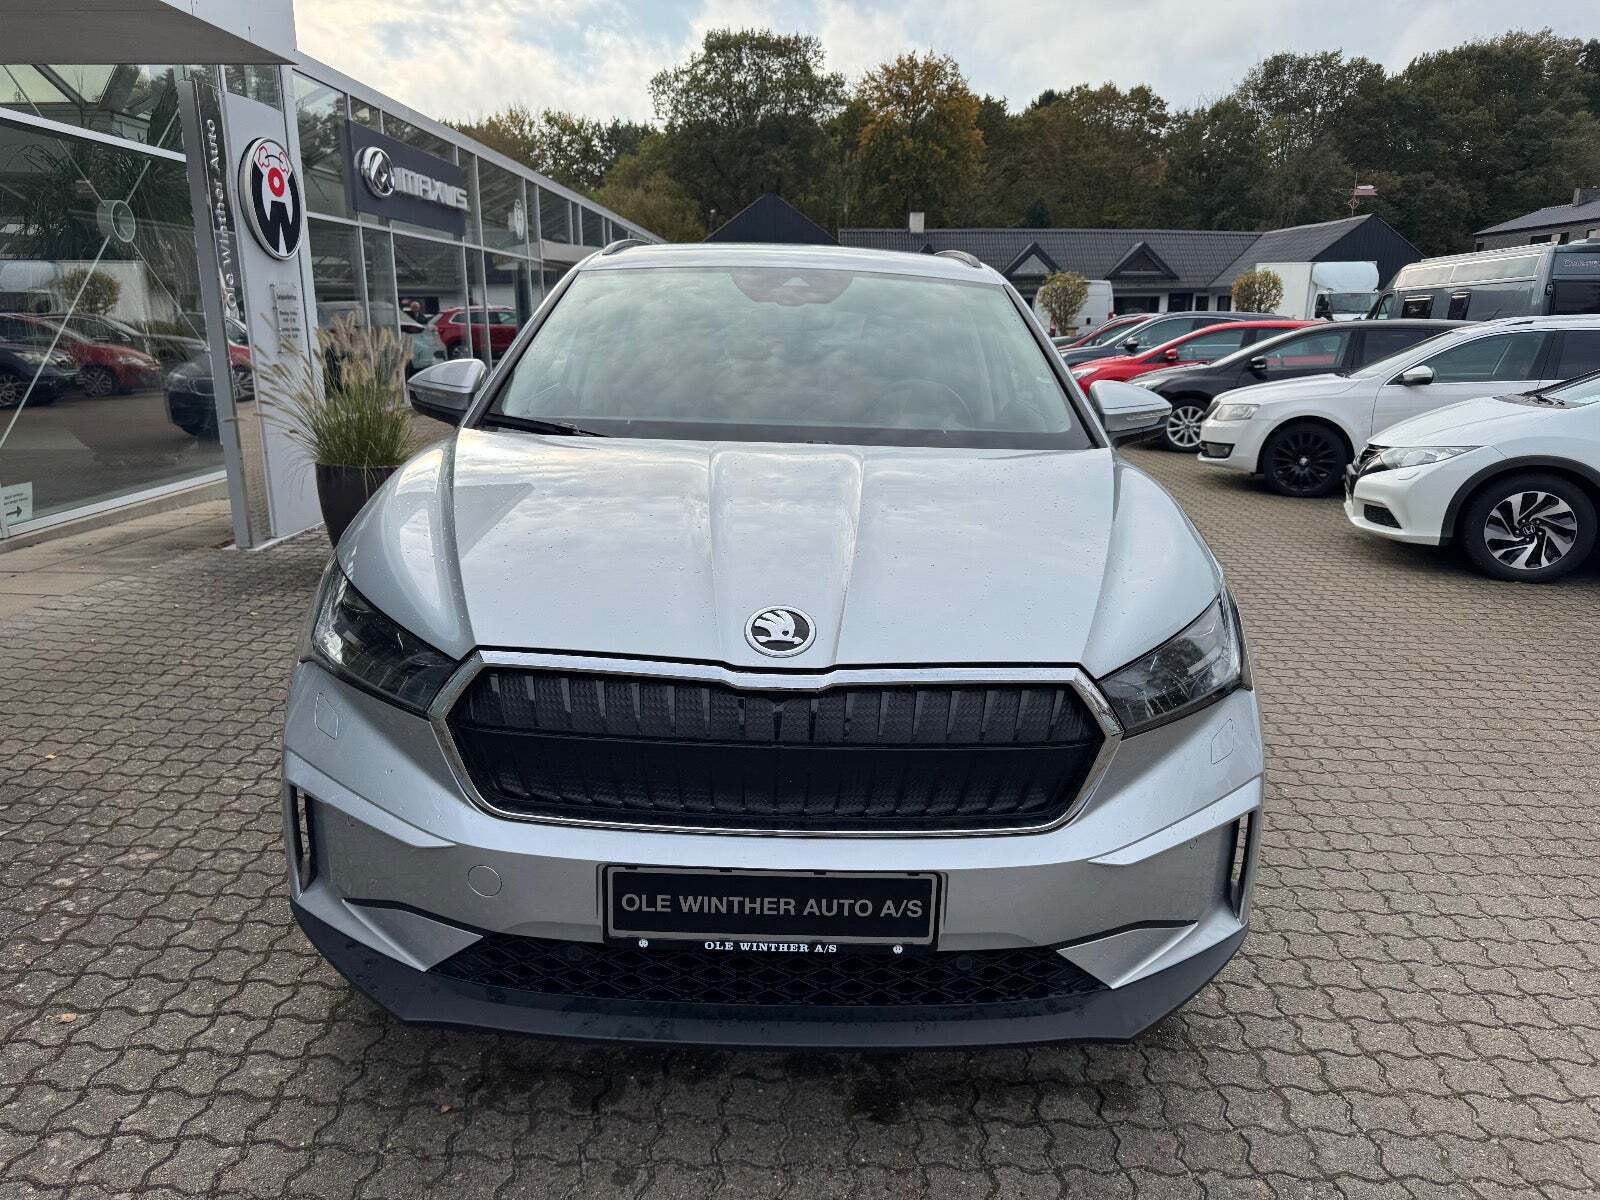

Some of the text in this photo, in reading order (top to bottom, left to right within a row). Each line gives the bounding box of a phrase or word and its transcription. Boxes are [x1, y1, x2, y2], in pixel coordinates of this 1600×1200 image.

[206, 119, 221, 175] Auto
[392, 167, 470, 212] MAXUS
[621, 893, 923, 919] OLE WINTHER AUTO A/S
[704, 941, 838, 954] OLE WINTHER A/S
